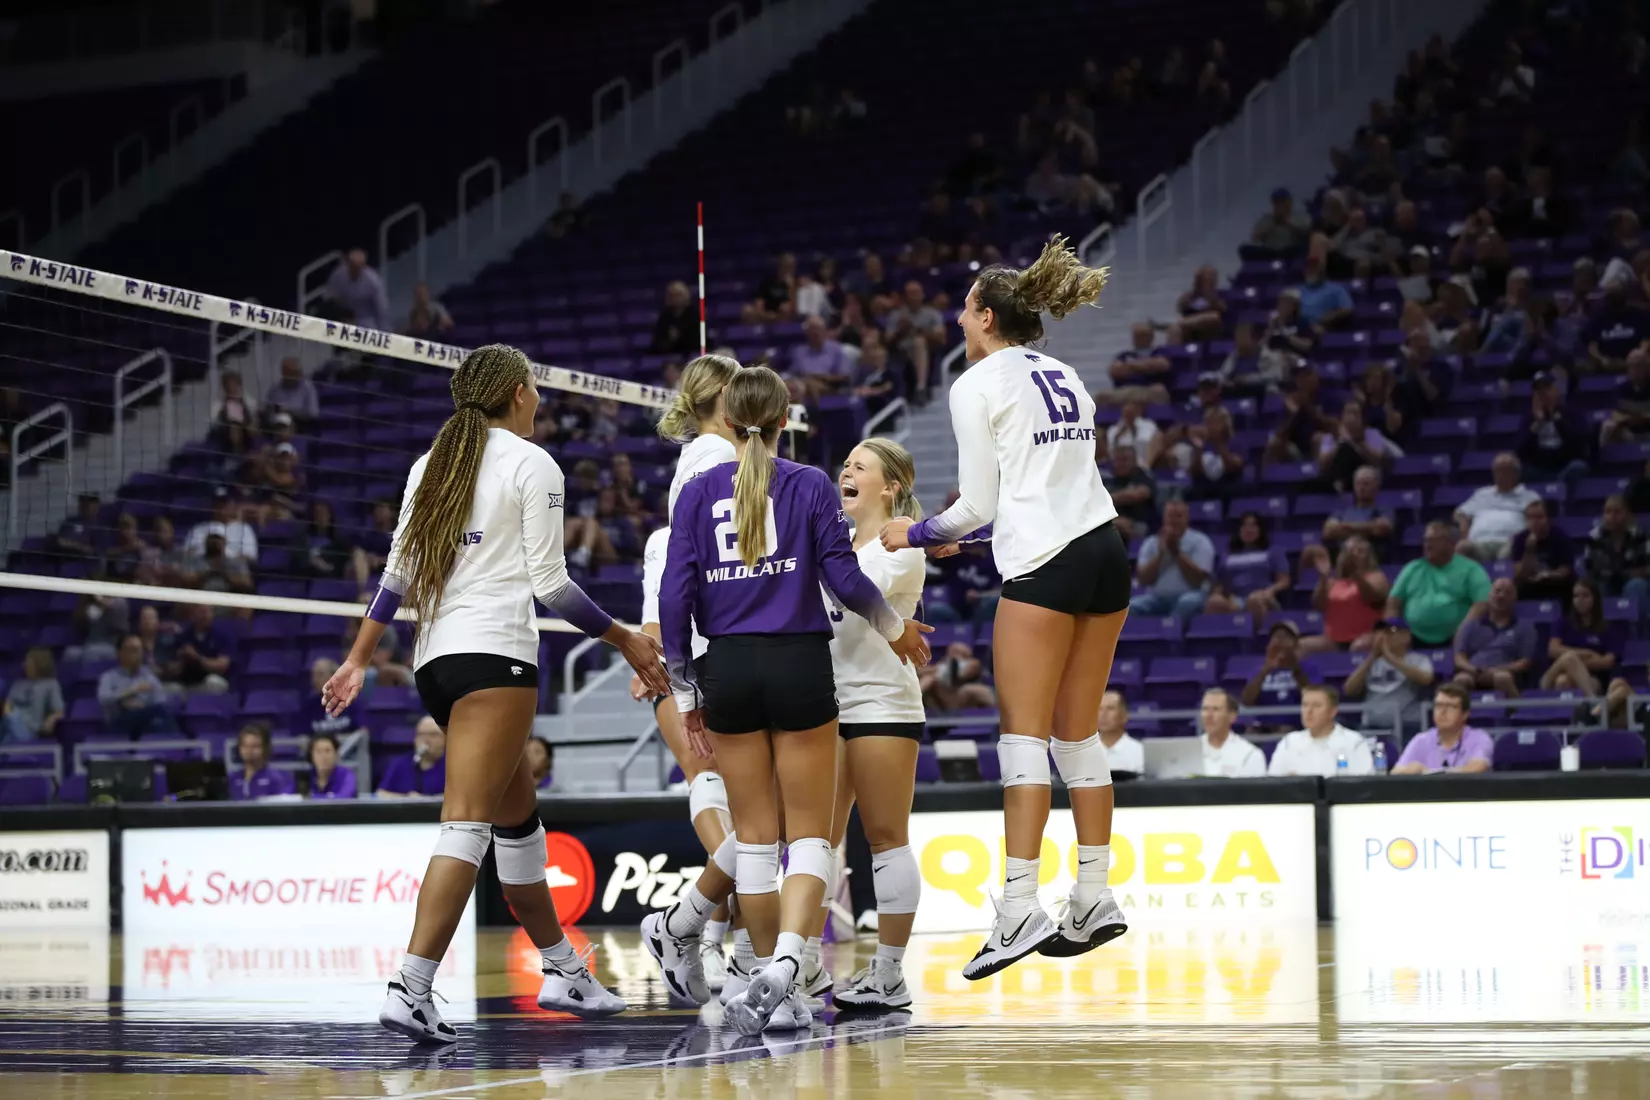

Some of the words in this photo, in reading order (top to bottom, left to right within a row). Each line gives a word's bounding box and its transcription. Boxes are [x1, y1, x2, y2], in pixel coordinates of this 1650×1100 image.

[29, 258, 96, 288] K-STATE
[142, 283, 204, 310] K-STATE
[246, 305, 302, 332] K-STATE
[339, 329, 392, 350] K-STATE
[581, 375, 623, 396] K-STATE
[1031, 370, 1081, 424] 15
[706, 557, 797, 584] WILDCATS
[1365, 834, 1507, 871] POINTE
[1185, 891, 1275, 909] EATS
